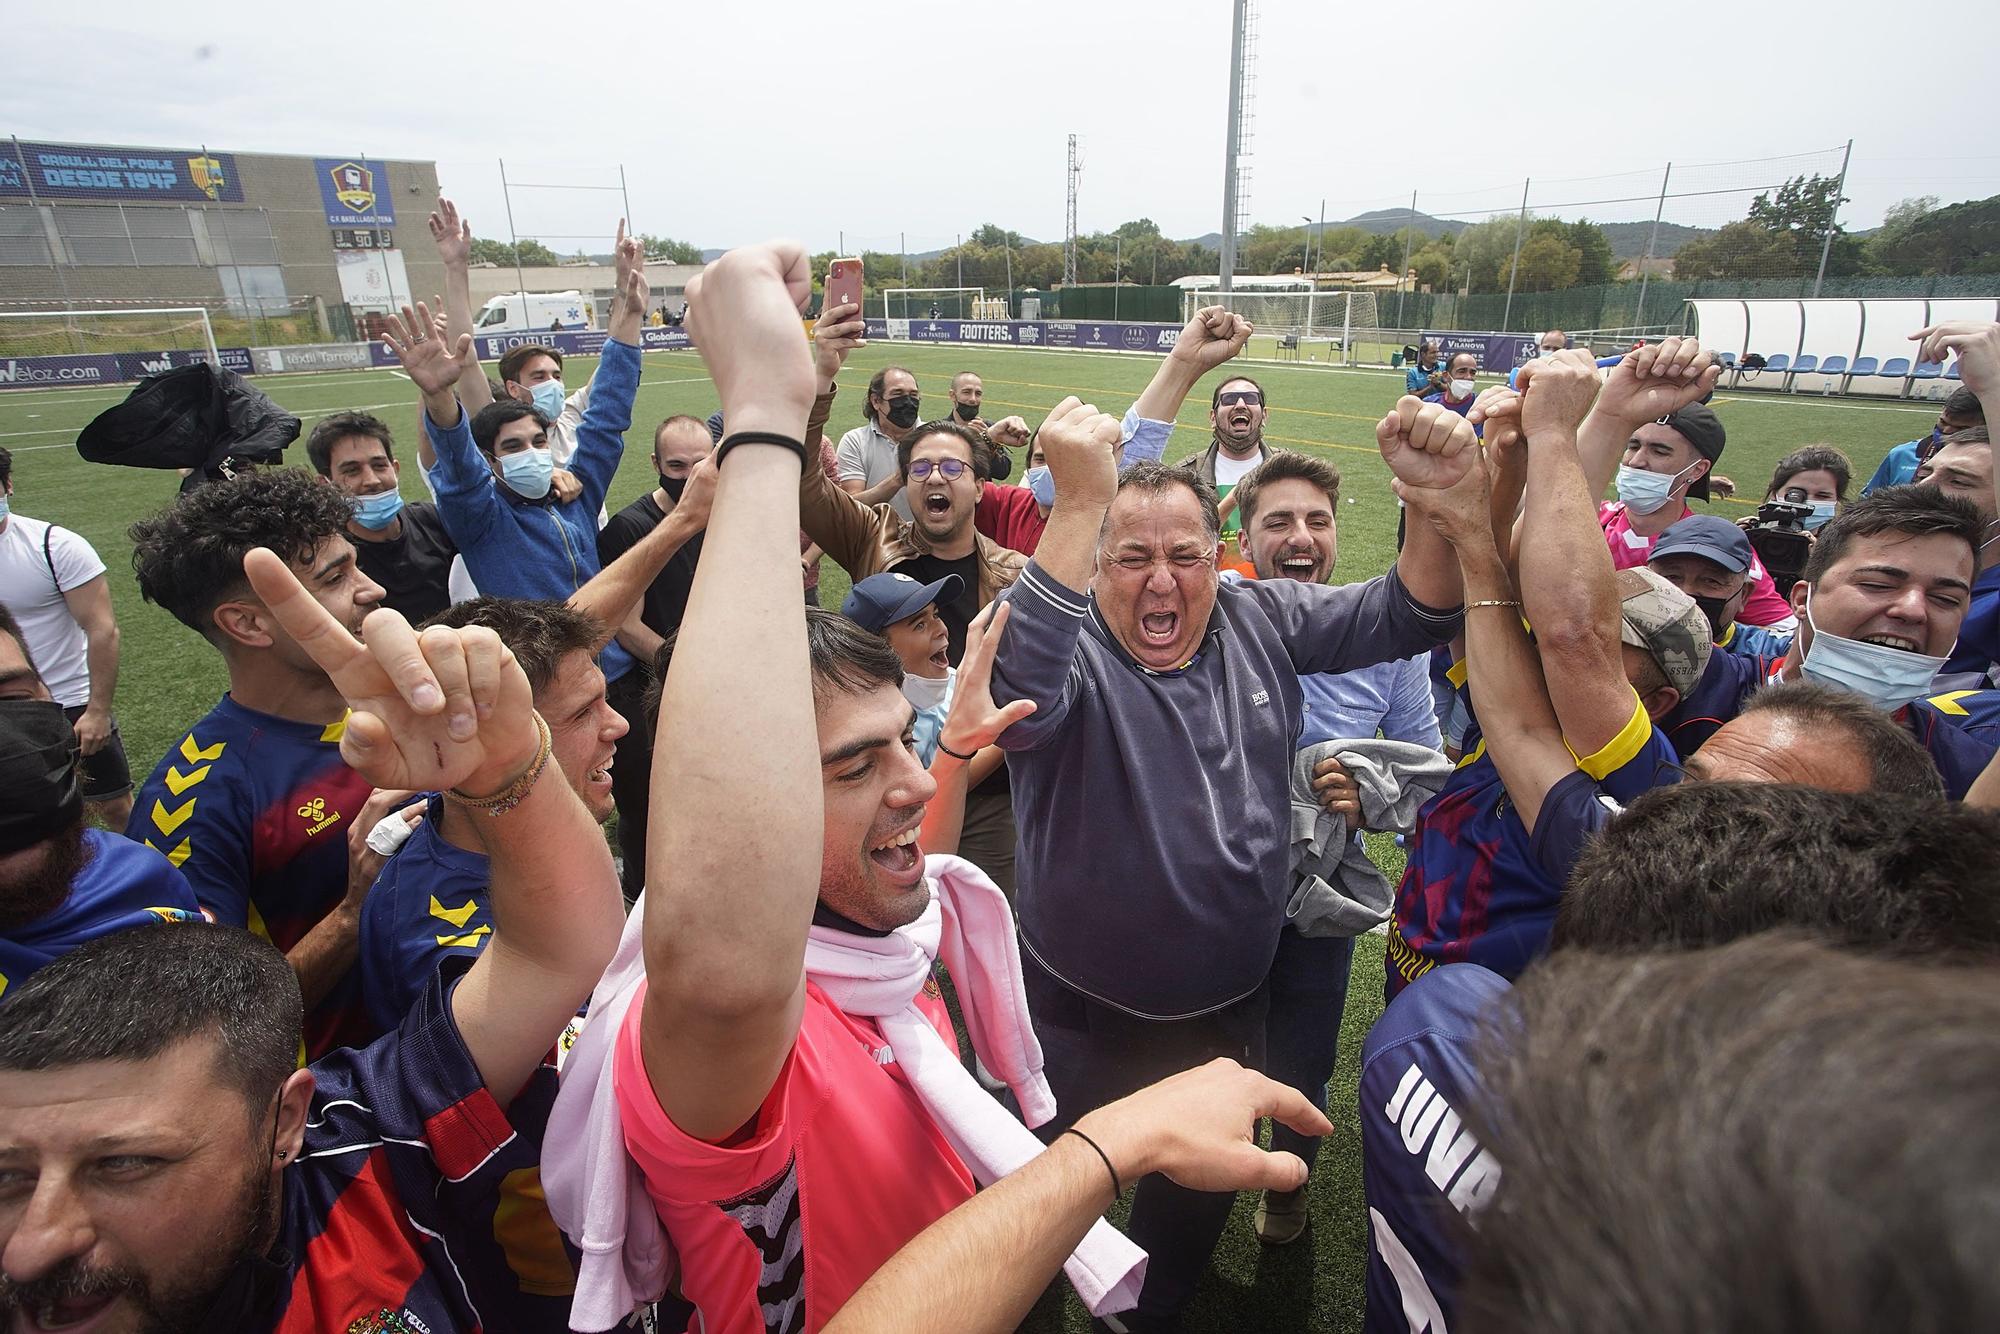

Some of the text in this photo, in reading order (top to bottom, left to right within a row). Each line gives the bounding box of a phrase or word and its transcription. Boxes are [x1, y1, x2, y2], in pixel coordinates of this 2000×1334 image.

[38, 154, 175, 171] ORGULL DEL POBLE
[42, 169, 124, 188] DESDE
[124, 171, 178, 189] 1947
[355, 235, 373, 248] 90
[1448, 340, 1485, 350] VILANOVA
[305, 811, 341, 837] hummel
